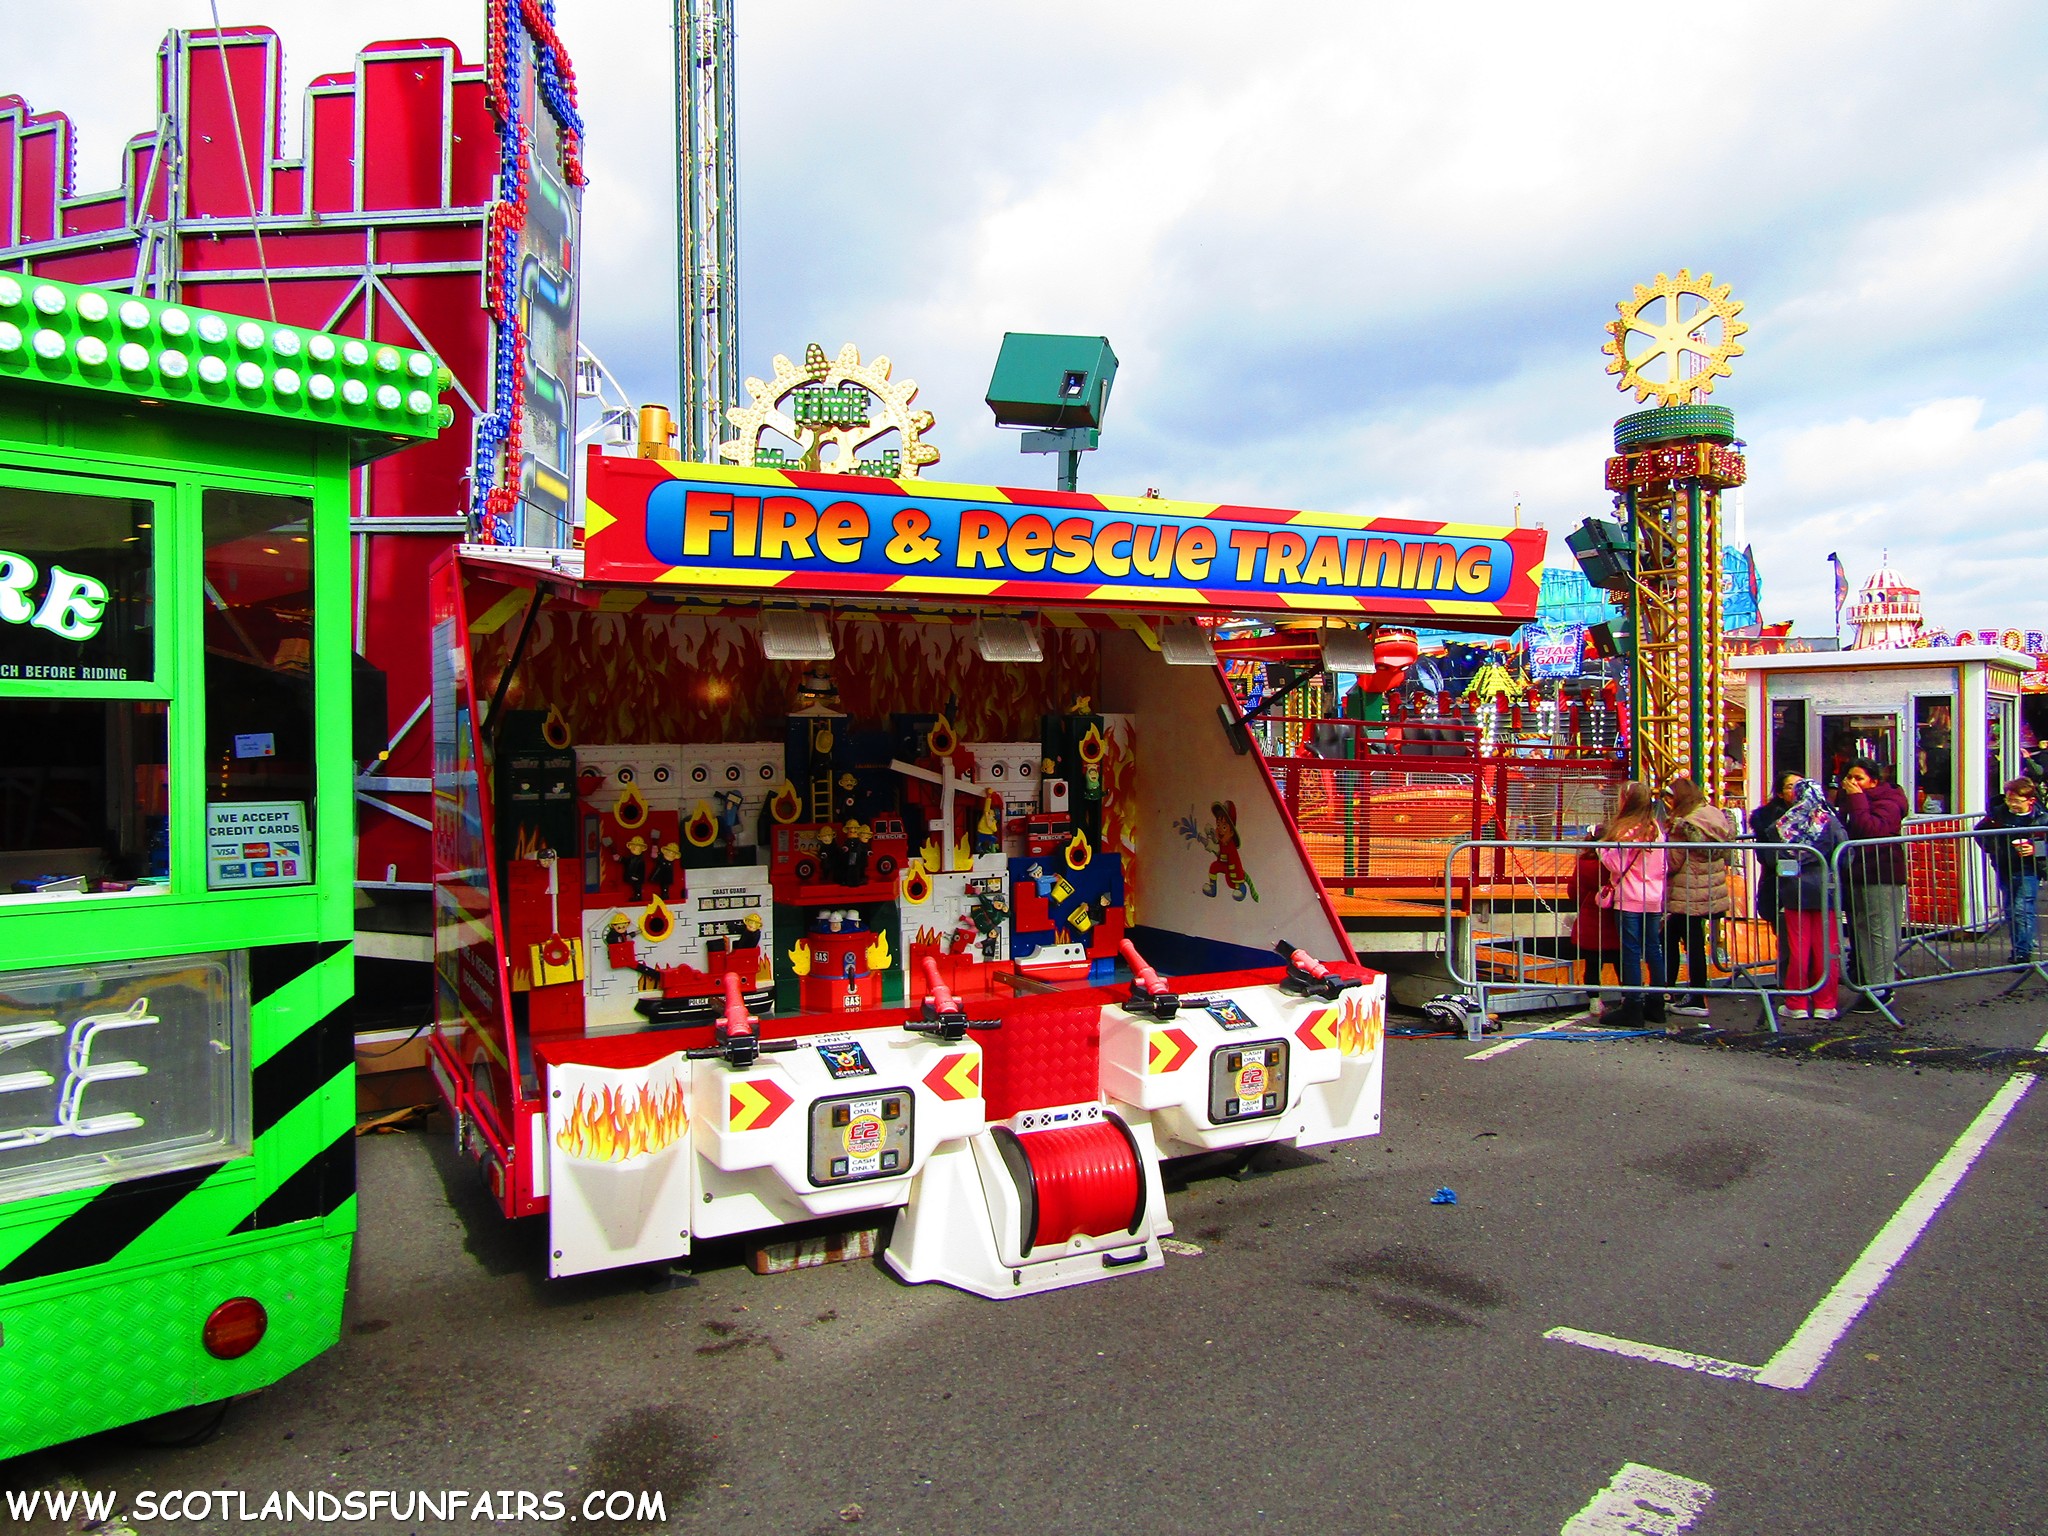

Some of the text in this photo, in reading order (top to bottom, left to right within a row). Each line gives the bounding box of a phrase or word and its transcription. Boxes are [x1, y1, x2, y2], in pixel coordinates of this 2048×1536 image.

[791, 387, 870, 424] TIME
[885, 508, 941, 564] &
[1535, 646, 1574, 656] STAR
[1535, 655, 1572, 665] GATE
[25, 665, 76, 678] BEFORE
[82, 667, 127, 680] RIDING
[217, 812, 289, 823] WE ACCEPT
[209, 824, 299, 836] CREDIT CARDS
[216, 848, 236, 856] VISA
[815, 952, 828, 962] GAS
[845, 996, 860, 1006] GAS
[817, 1035, 852, 1043] ONLY
[1240, 1069, 1262, 1084] £2
[853, 1107, 878, 1115] ONLY
[850, 1121, 879, 1140] £2
[851, 1164, 875, 1172] ONLY
